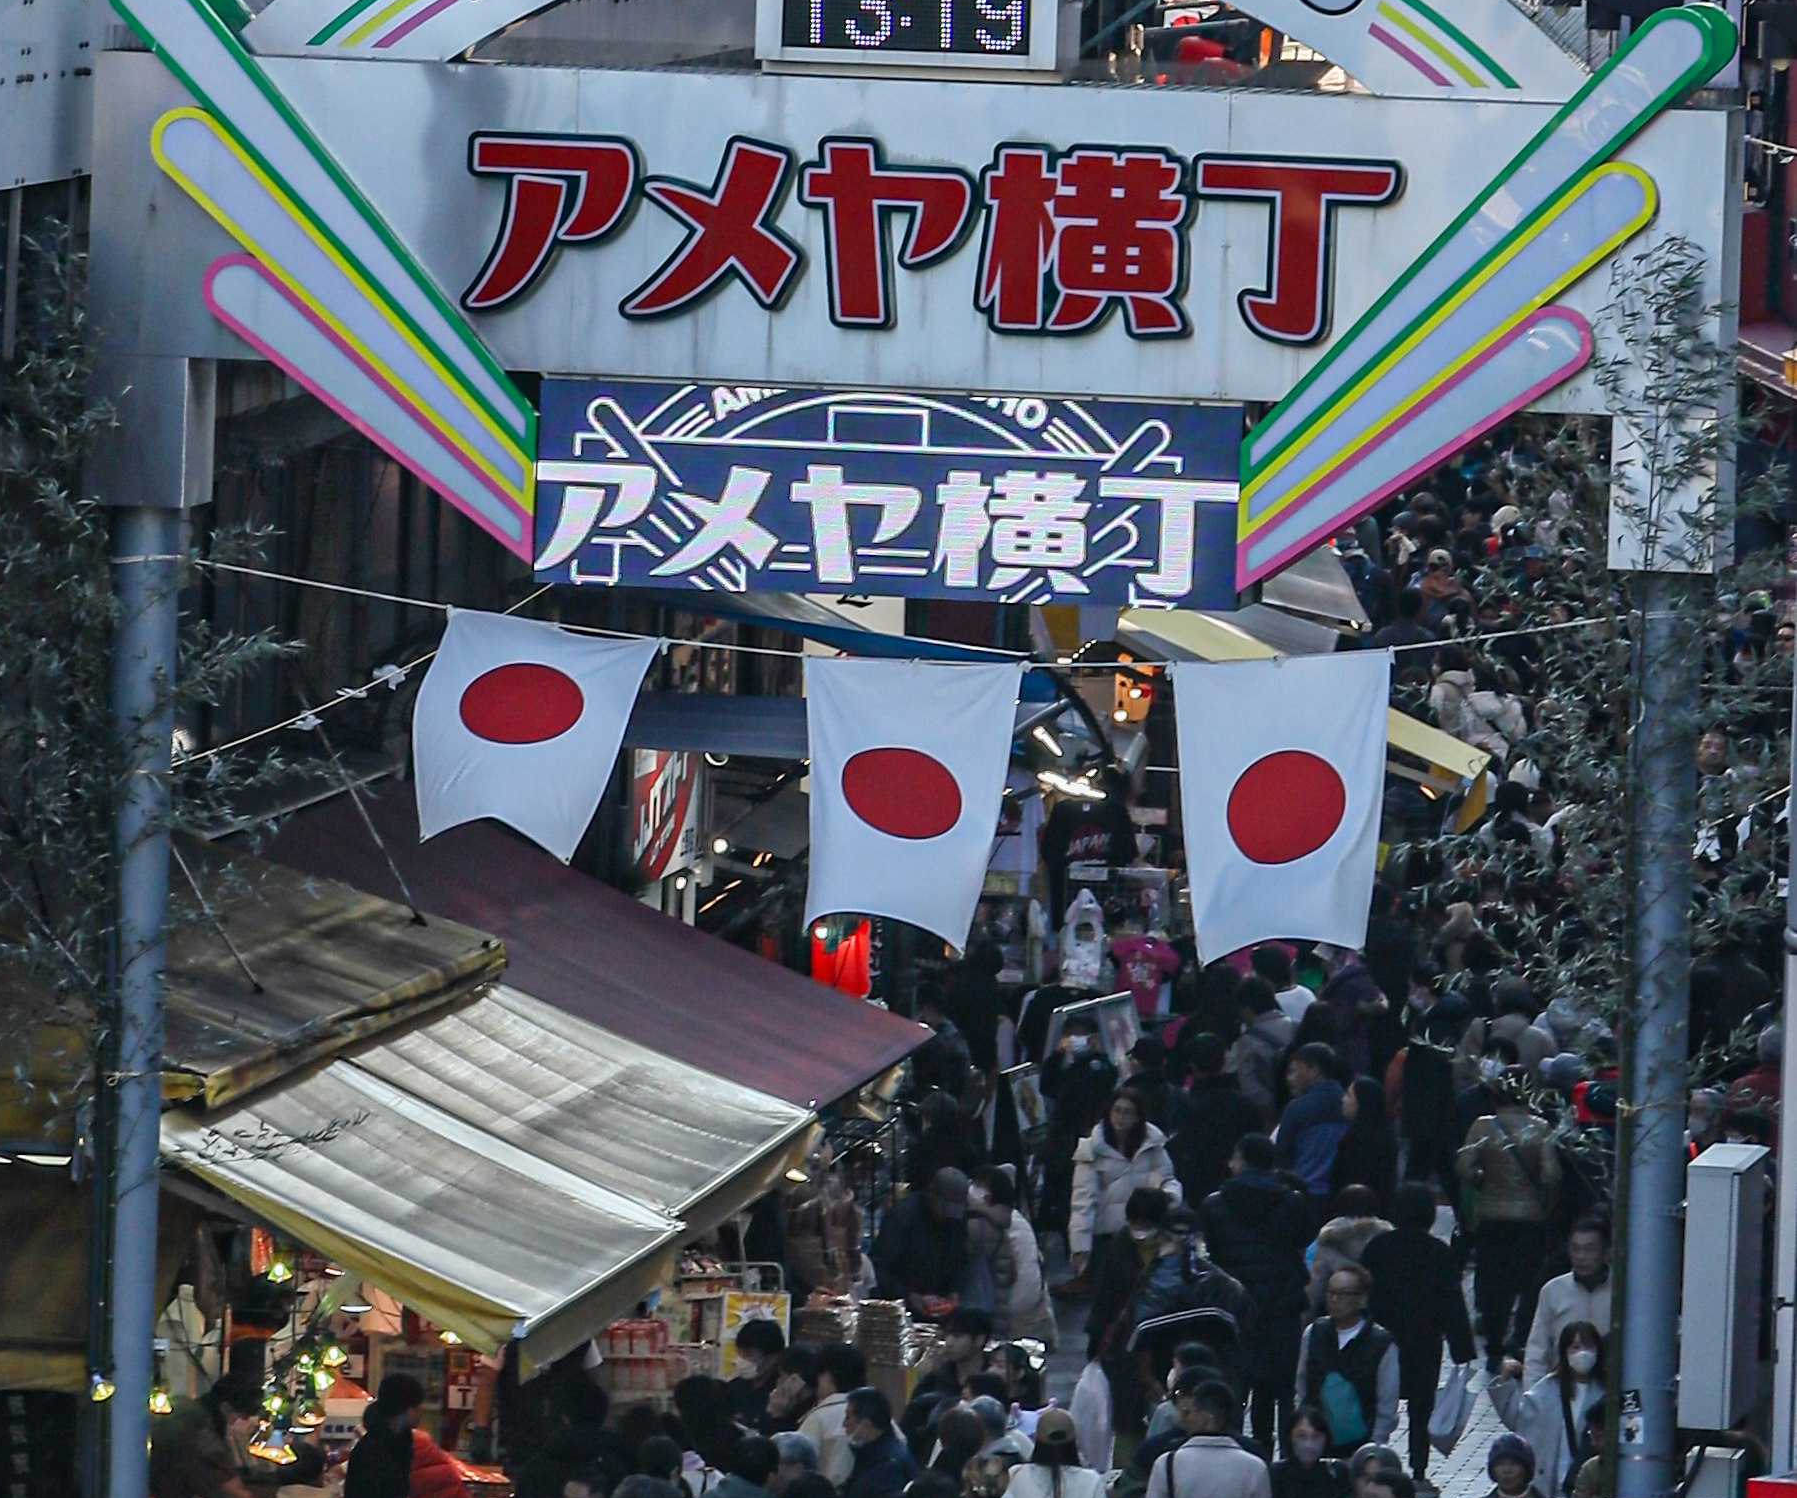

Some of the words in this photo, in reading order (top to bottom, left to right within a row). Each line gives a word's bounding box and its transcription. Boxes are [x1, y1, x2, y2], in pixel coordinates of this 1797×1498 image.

[460, 130, 1404, 346] アメヤ横丁
[534, 460, 1240, 596] アメヤ横丁
